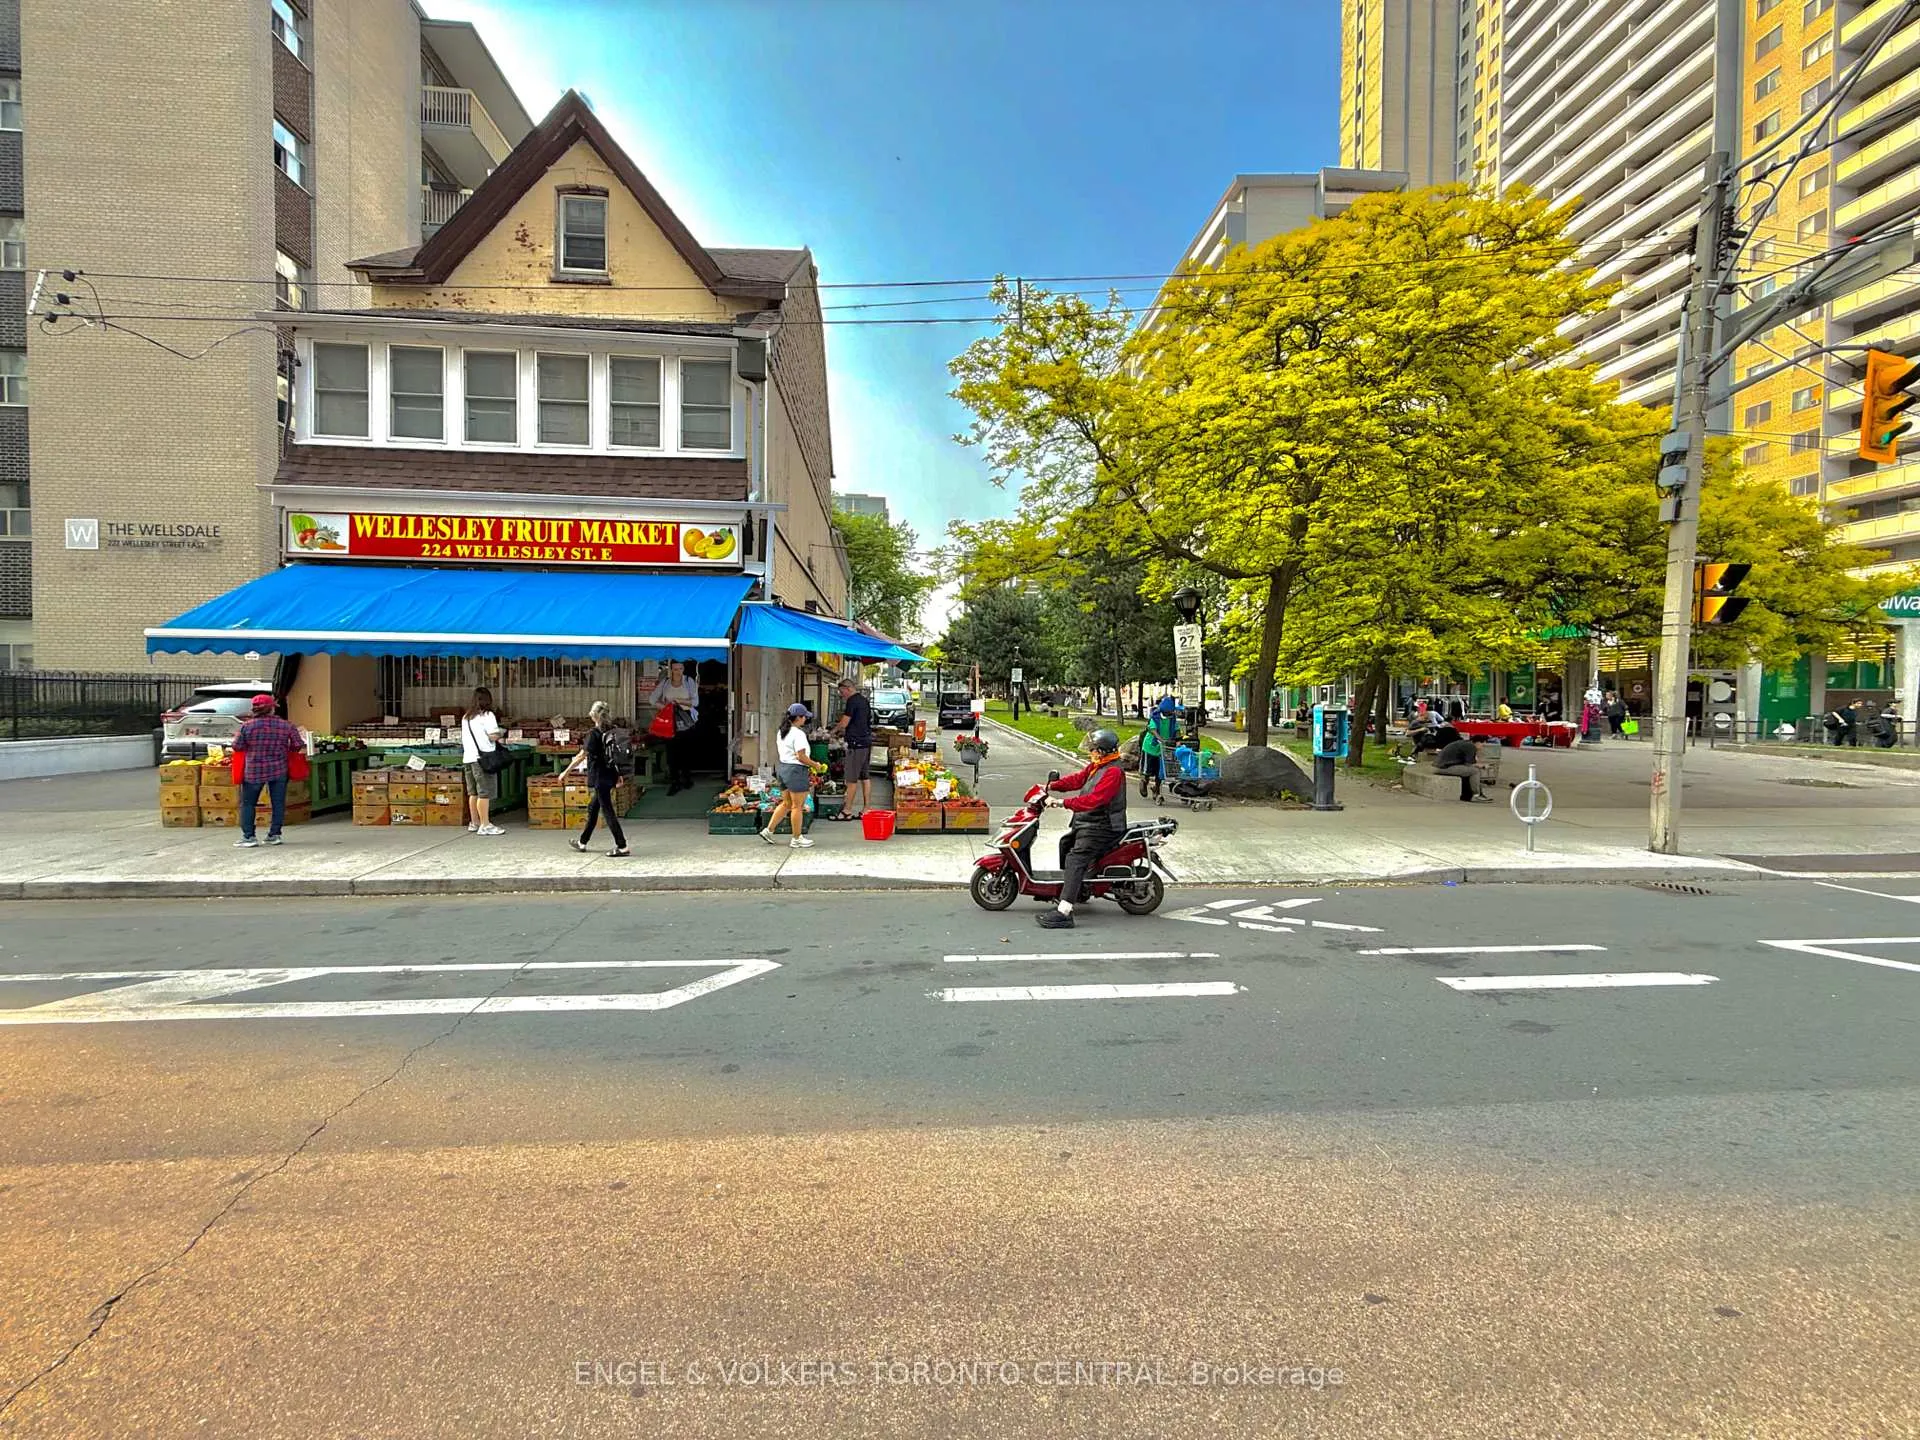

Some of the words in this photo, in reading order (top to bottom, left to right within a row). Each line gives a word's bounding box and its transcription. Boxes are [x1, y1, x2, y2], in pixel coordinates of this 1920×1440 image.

[70, 525, 93, 543] W
[107, 522, 135, 536] THE
[138, 523, 221, 538] WELLSDALE
[352, 514, 496, 541] WELLESLEY
[500, 518, 574, 543] FRUIT
[578, 520, 678, 545] MARKET
[421, 543, 452, 557] 224
[455, 544, 568, 559] WELLESLEY
[570, 546, 597, 561] ST.
[600, 548, 613, 561] E
[1179, 635, 1194, 647] 27
